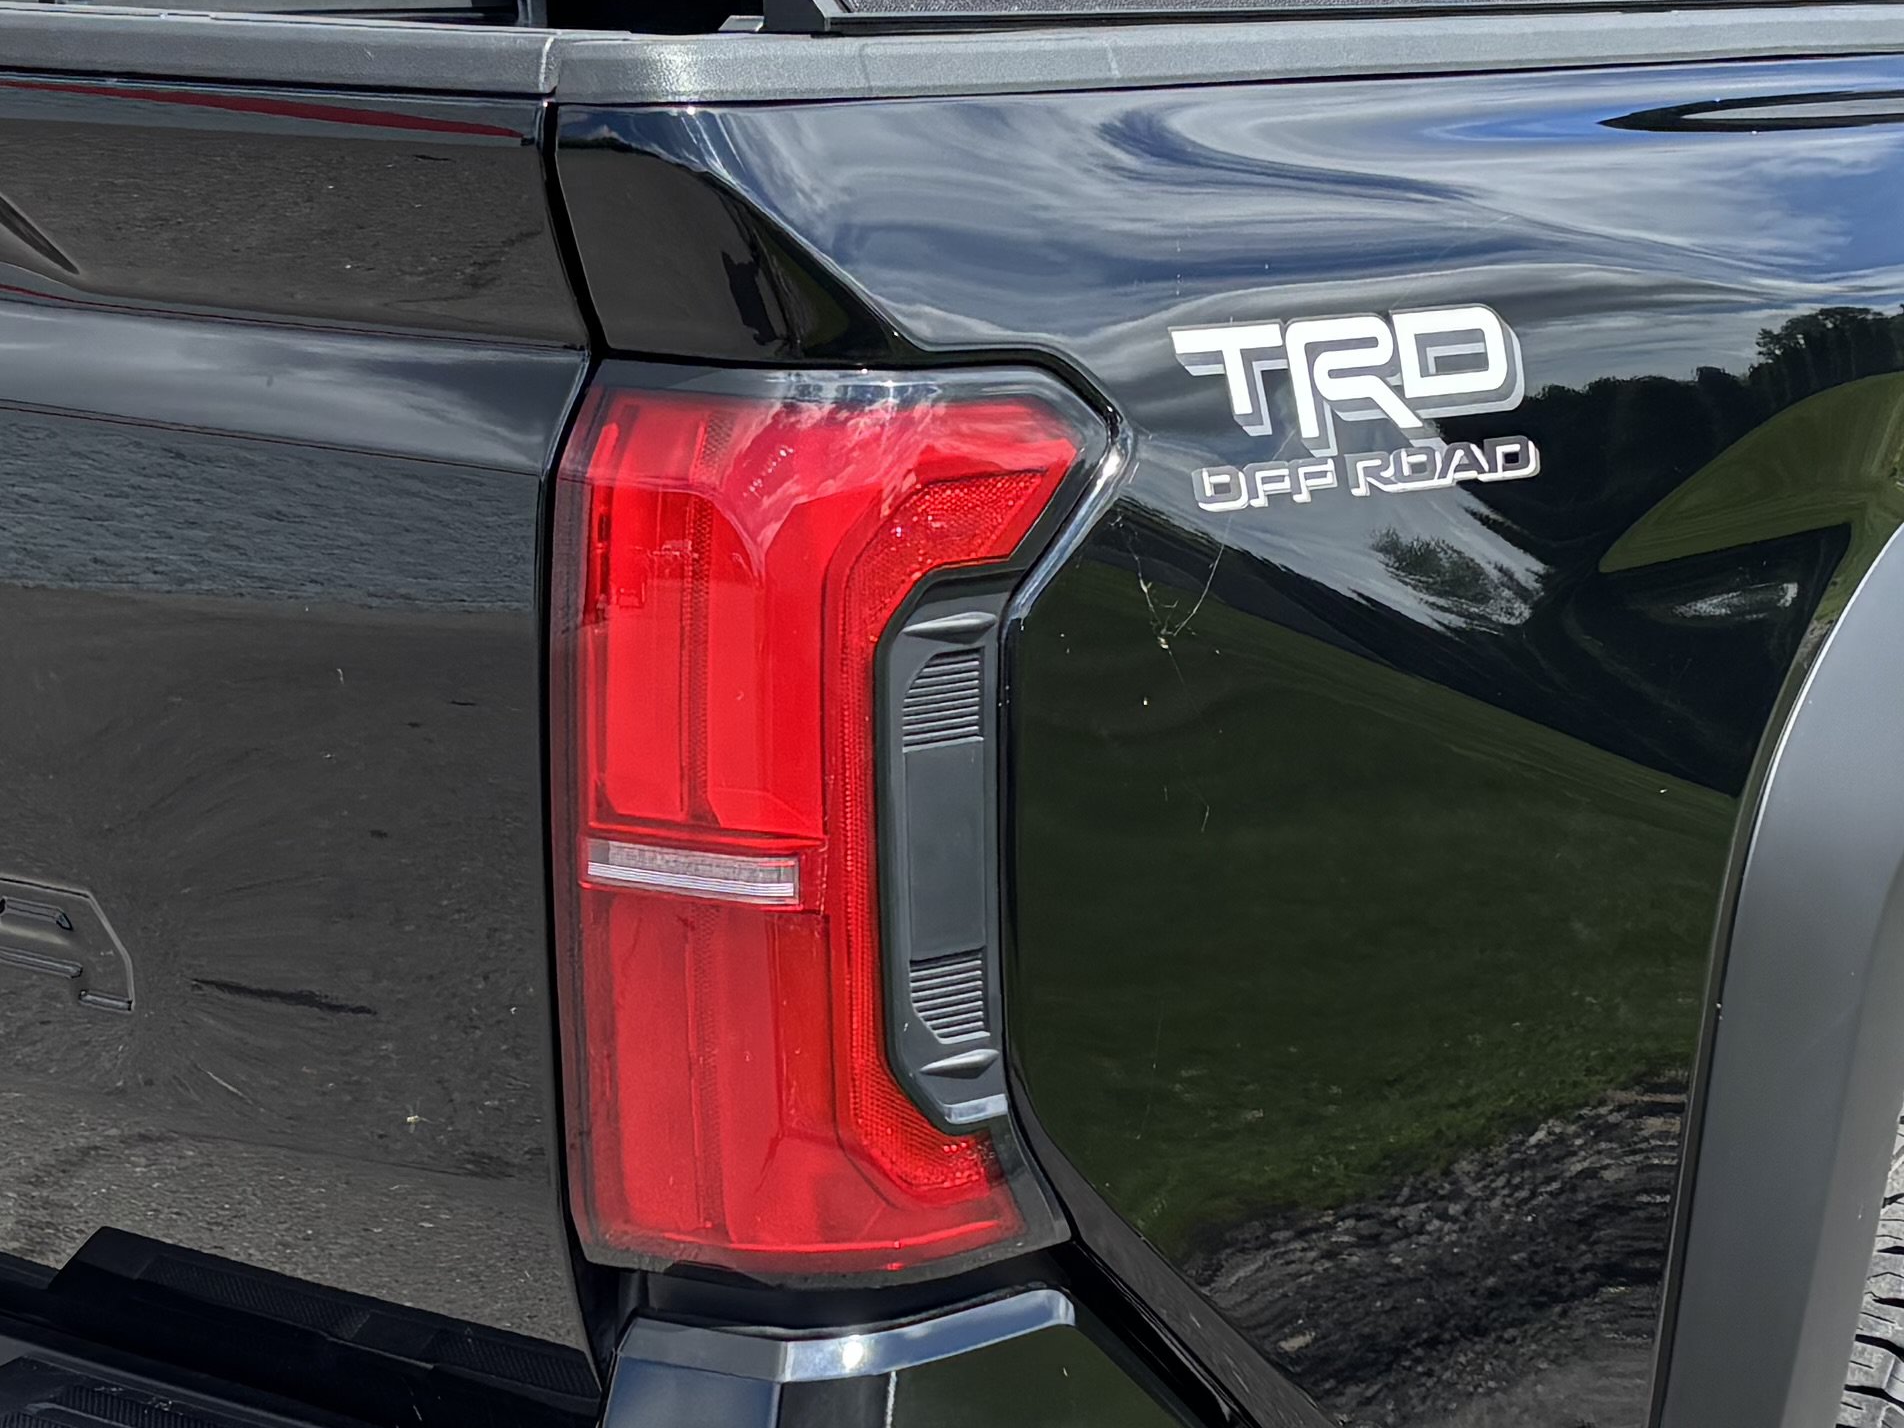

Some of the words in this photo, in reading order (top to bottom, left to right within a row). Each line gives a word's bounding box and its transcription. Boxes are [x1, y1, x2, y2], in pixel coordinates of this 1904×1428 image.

[1168, 303, 1525, 457] TRD
[1192, 456, 1339, 512] OFF
[1345, 435, 1542, 498] ROAD
